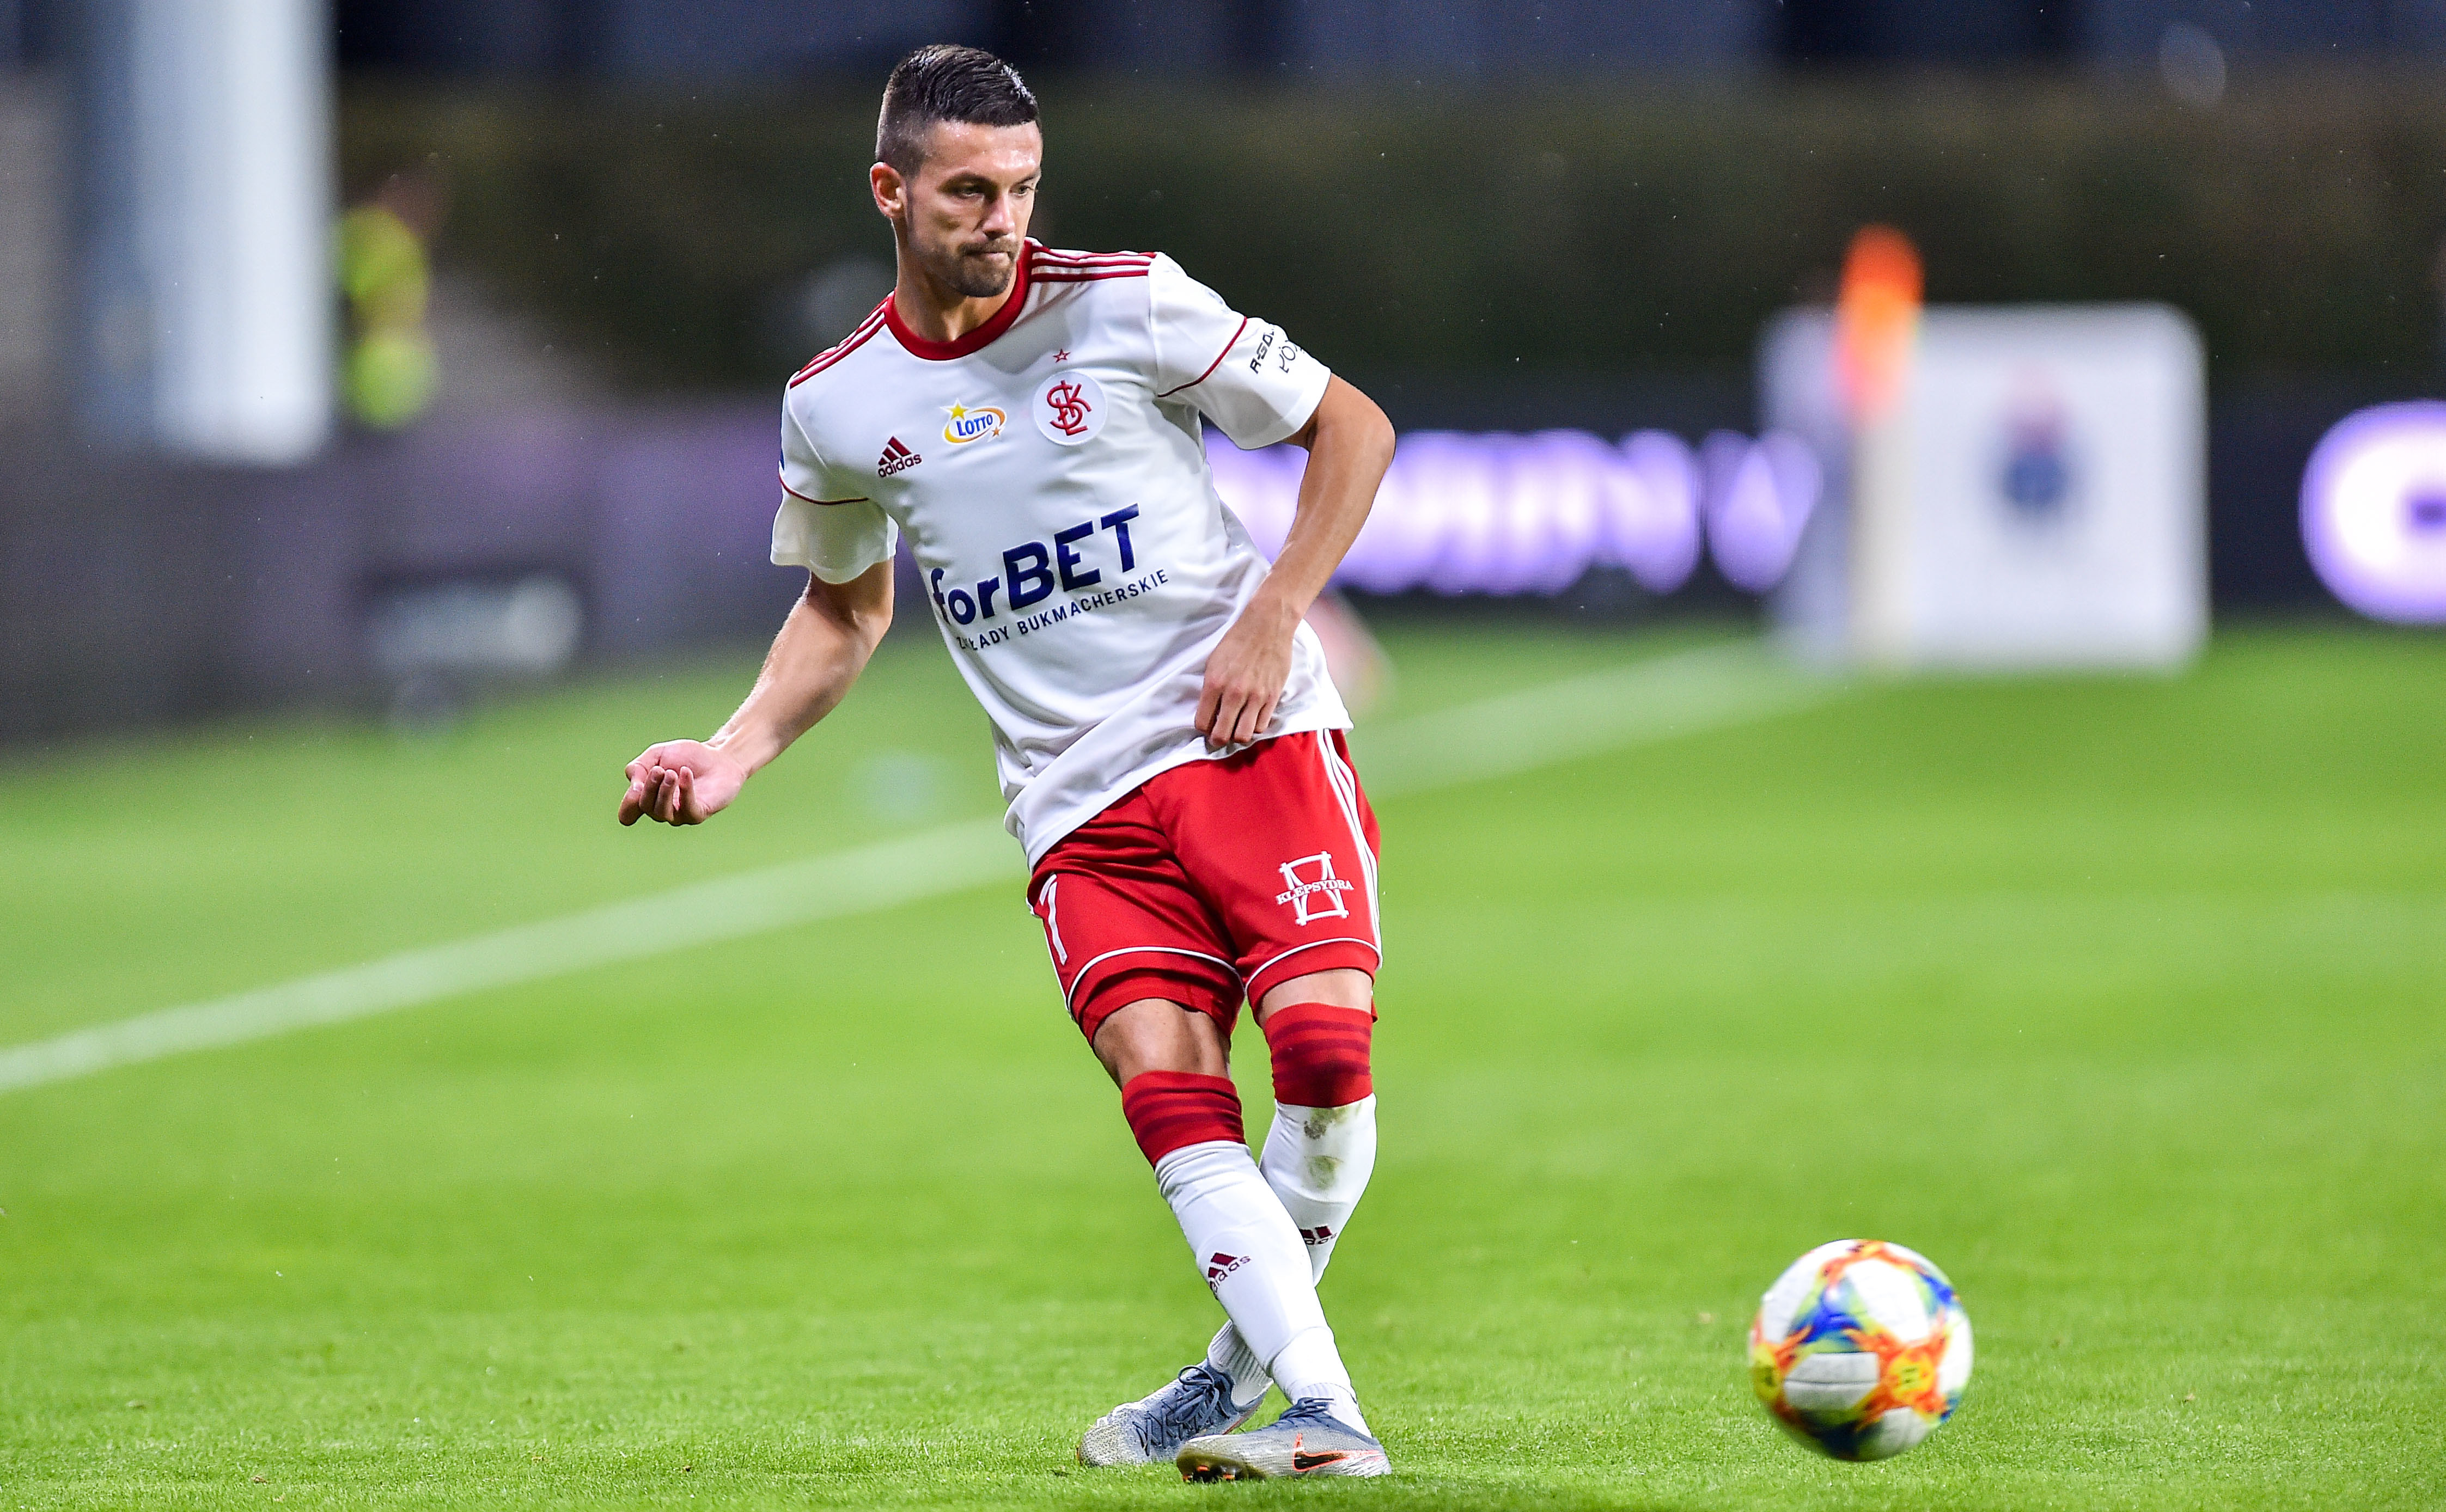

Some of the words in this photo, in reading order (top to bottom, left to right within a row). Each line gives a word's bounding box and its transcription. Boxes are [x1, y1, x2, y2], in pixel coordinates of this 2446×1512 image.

[956, 414, 993, 436] LOTTO
[878, 454, 923, 478] adidas
[930, 503, 1140, 626] forBET
[1017, 569, 1169, 635] BUKMACHERSKIE
[1276, 879, 1355, 905] KLEPSYDRA
